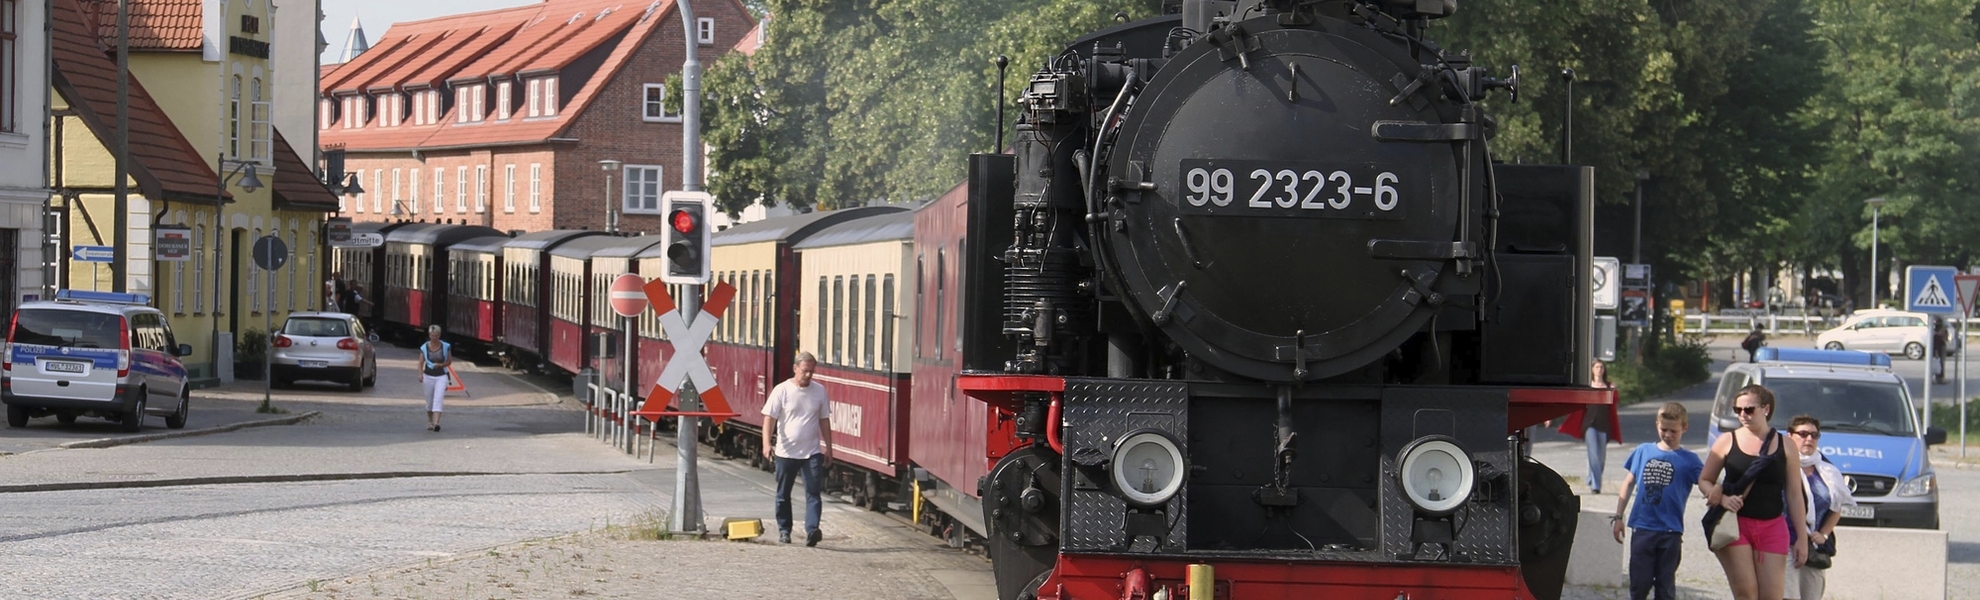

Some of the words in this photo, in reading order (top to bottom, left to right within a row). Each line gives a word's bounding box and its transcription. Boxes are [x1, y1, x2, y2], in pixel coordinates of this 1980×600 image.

[1186, 168, 1235, 207] 99
[1248, 168, 1399, 211] 2323-6
[20, 346, 46, 355] POLIZEI
[1819, 446, 1883, 459] OLIZEI
[1847, 506, 1873, 517] 32013
